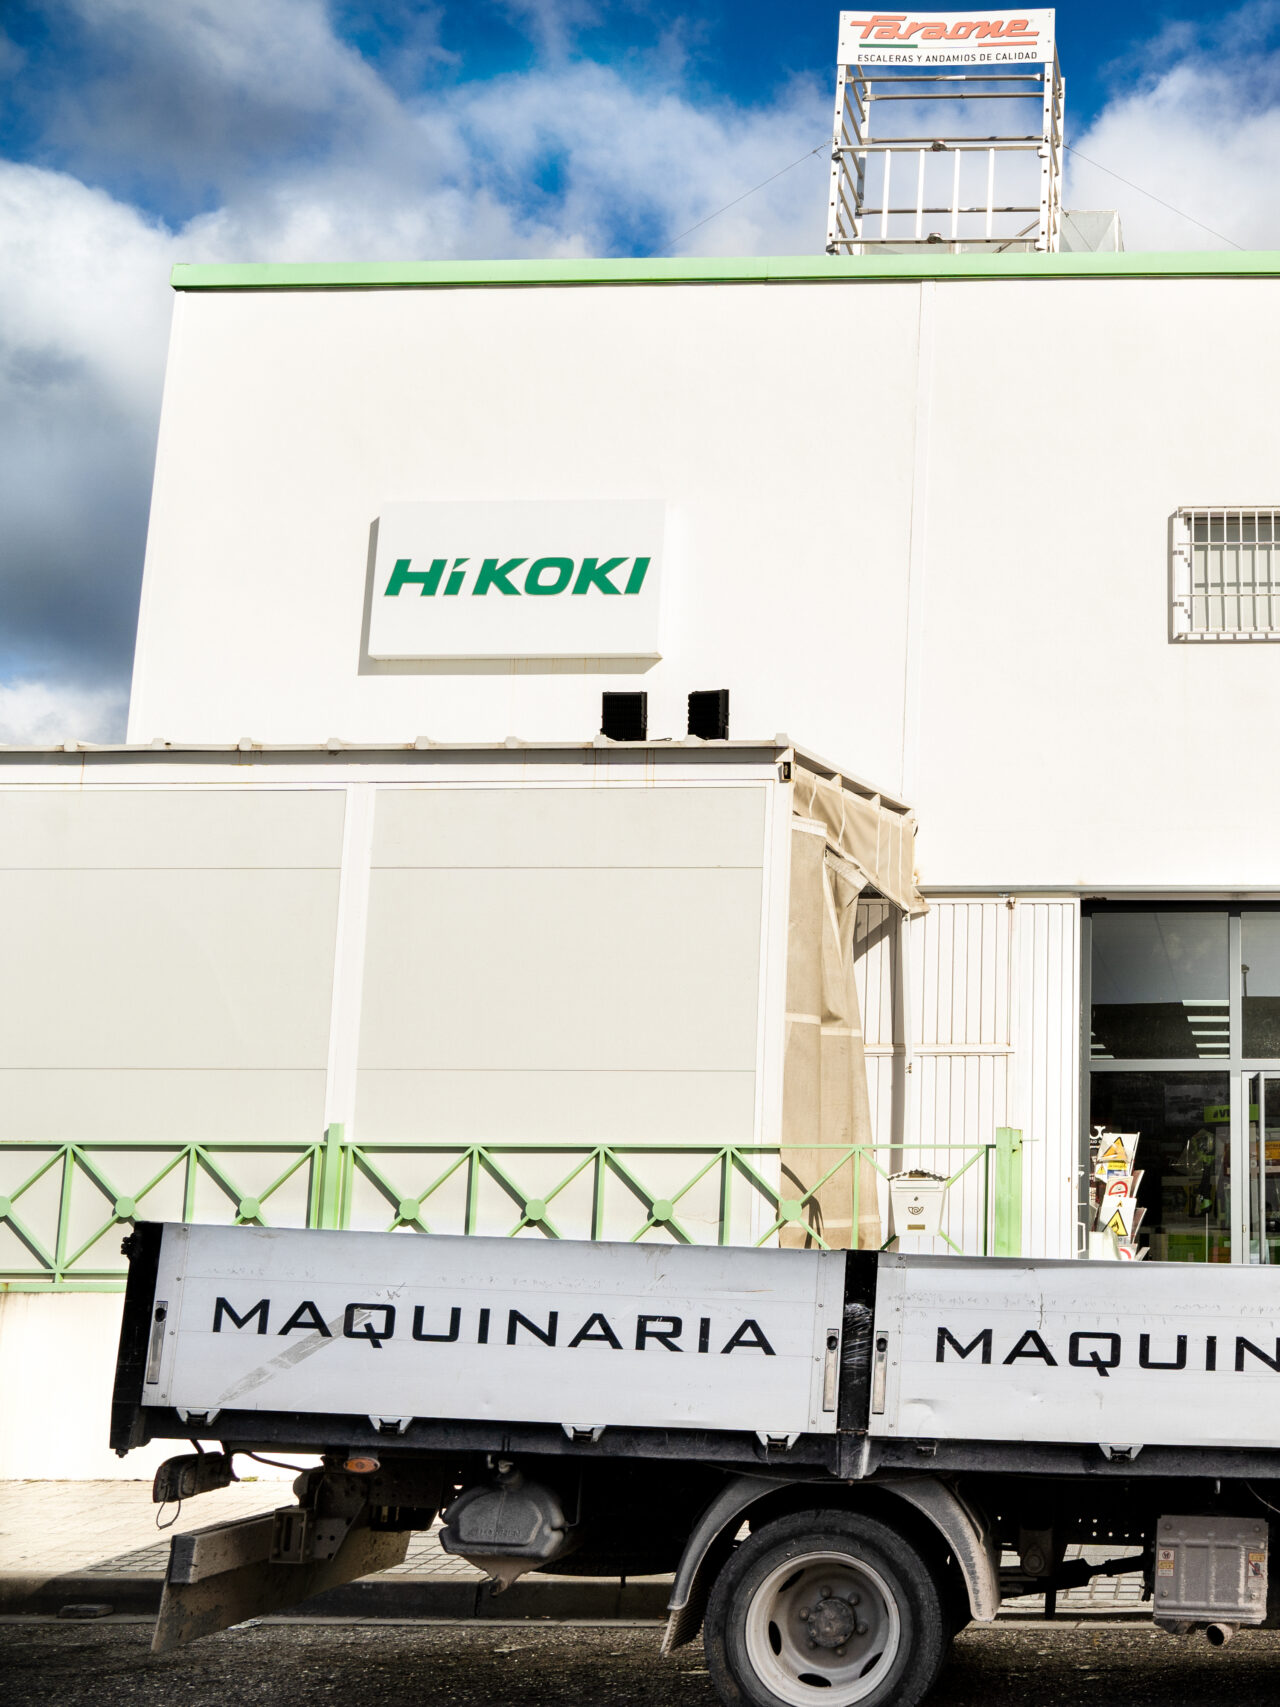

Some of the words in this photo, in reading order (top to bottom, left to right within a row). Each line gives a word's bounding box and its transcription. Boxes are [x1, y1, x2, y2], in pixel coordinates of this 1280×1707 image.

[857, 54, 914, 63] ESCALERAS
[917, 54, 922, 63] Y
[925, 53, 976, 63] ANDAMIOS
[979, 53, 992, 62] DE
[995, 51, 1038, 61] CALIDAD
[212, 1297, 777, 1357] MAQUINARIA
